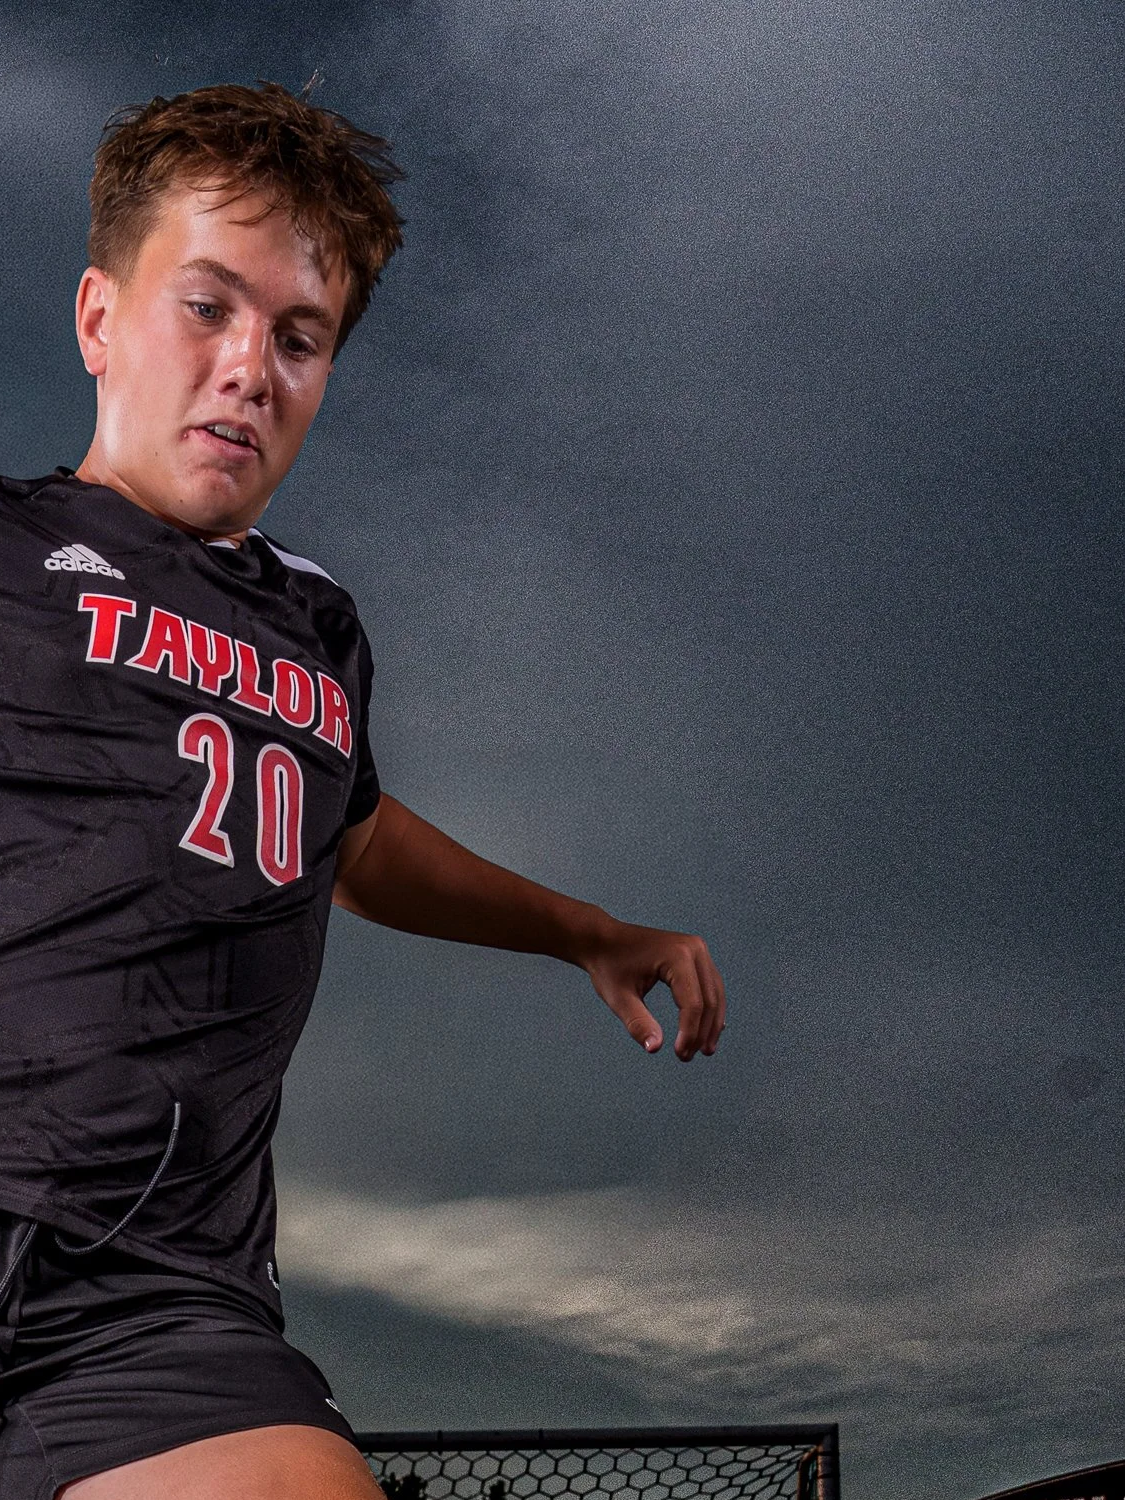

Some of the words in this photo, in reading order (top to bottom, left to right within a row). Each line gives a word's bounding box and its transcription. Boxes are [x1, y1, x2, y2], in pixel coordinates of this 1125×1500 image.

[44, 557, 126, 581] adidas
[78, 592, 352, 759] TAYLOR
[177, 712, 304, 887] 20
